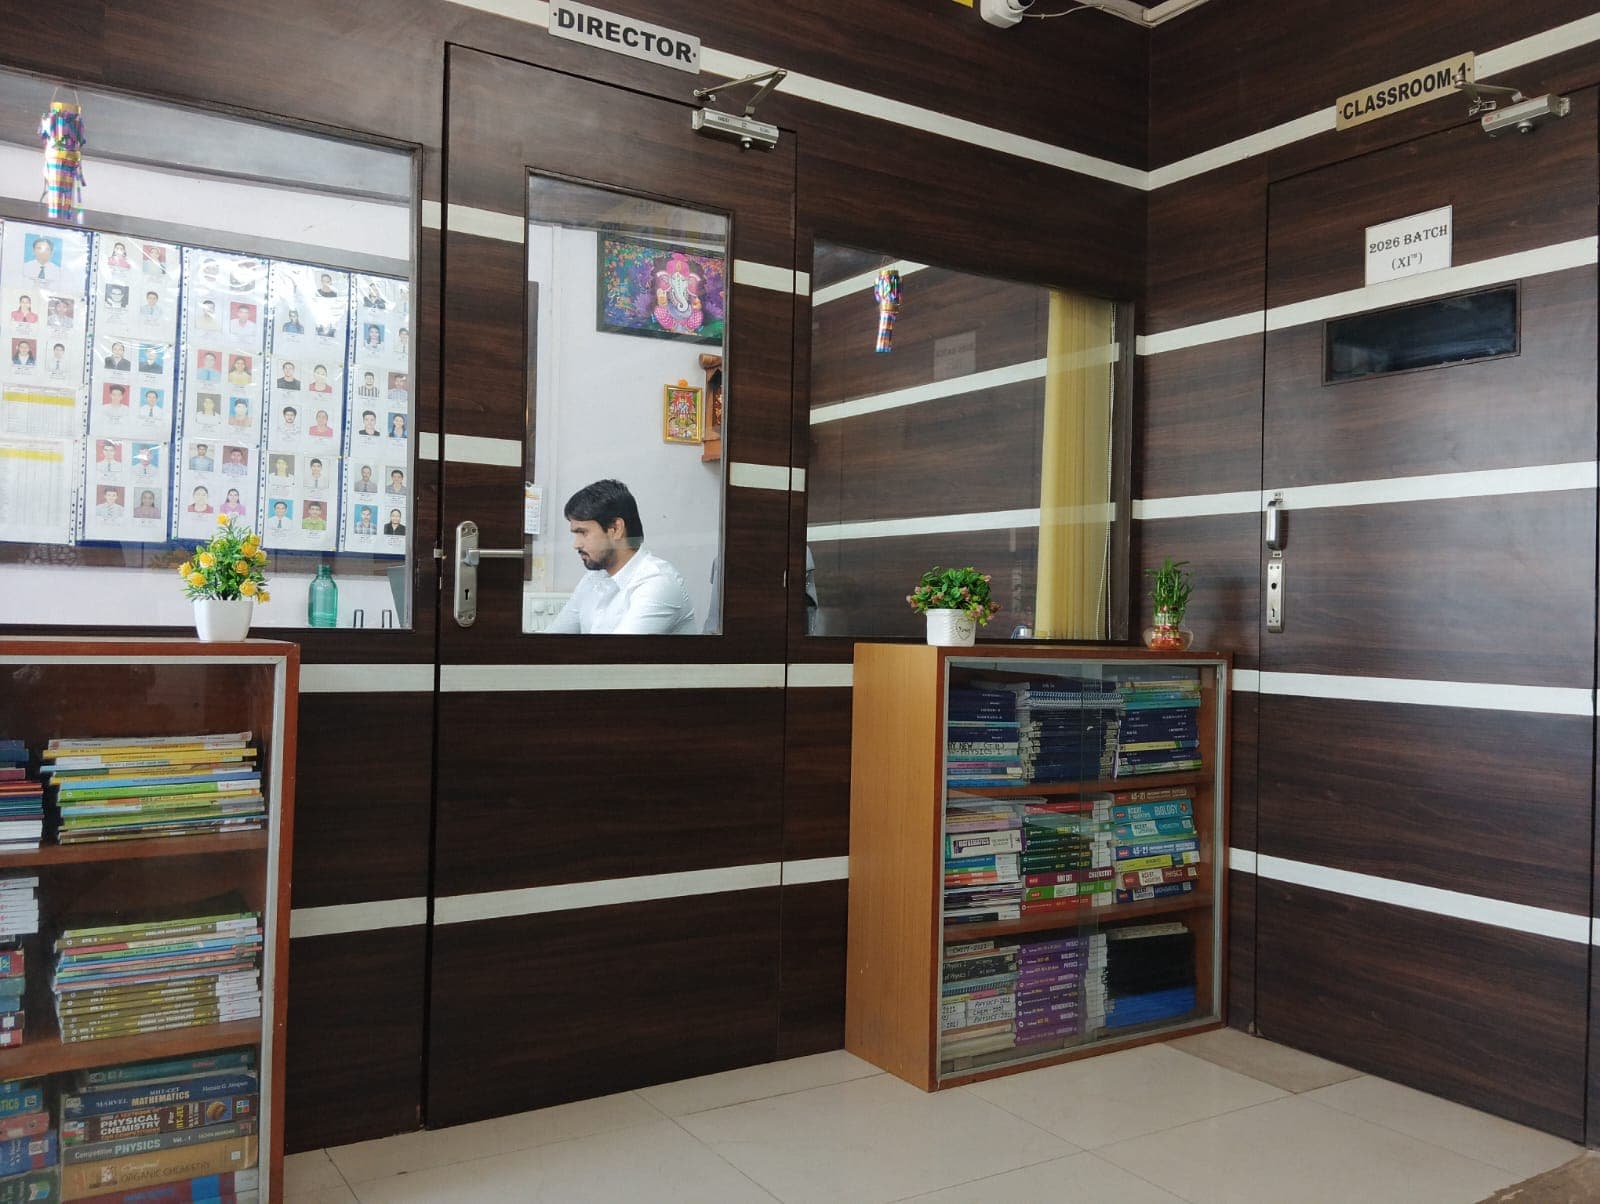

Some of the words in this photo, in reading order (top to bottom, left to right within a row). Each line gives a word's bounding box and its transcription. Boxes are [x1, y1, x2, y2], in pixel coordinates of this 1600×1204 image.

[557, 8, 692, 63] DIRECTOR
[1369, 237, 1401, 254] 2026
[1404, 225, 1448, 246] BATCH
[131, 1091, 190, 1107] MATHEMATICS
[100, 1113, 160, 1128] PHYSICAL
[100, 1120, 160, 1136] CHEMISTRY
[115, 1139, 161, 1155] PHYSICS
[120, 1168, 161, 1183] ORGANIC
[163, 1161, 211, 1176] CHEMISTRY
